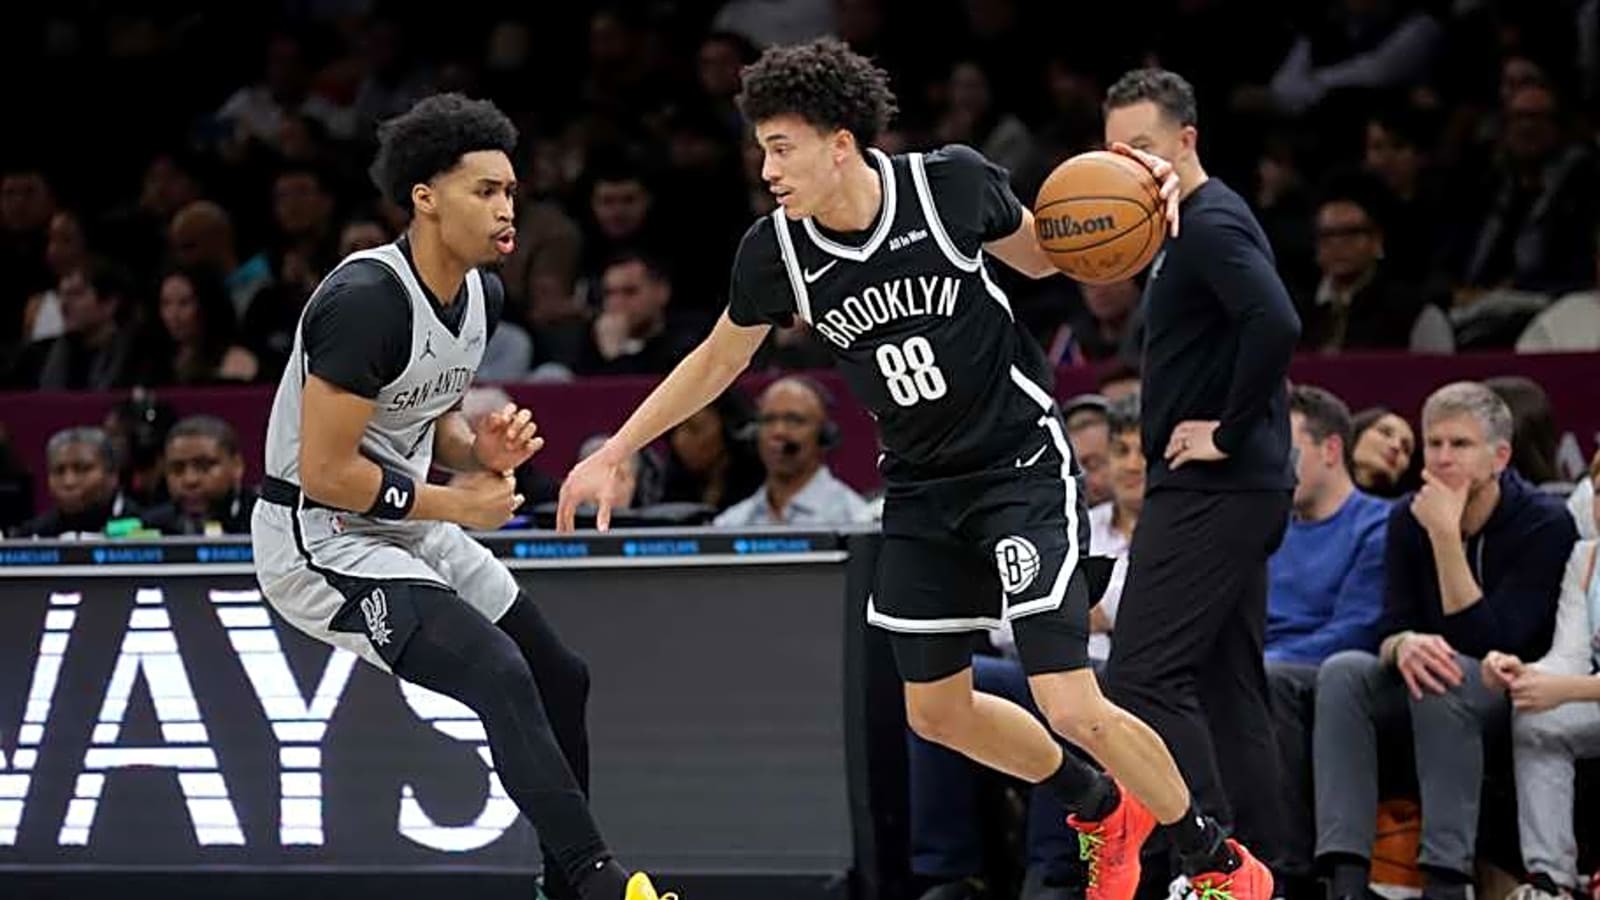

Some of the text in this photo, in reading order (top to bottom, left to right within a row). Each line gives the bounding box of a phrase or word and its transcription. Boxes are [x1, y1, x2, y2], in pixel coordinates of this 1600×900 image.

[1037, 214, 1115, 240] Wilson
[816, 276, 961, 349] BROOKLYN
[387, 380, 433, 412] SAN
[876, 336, 947, 407] 88
